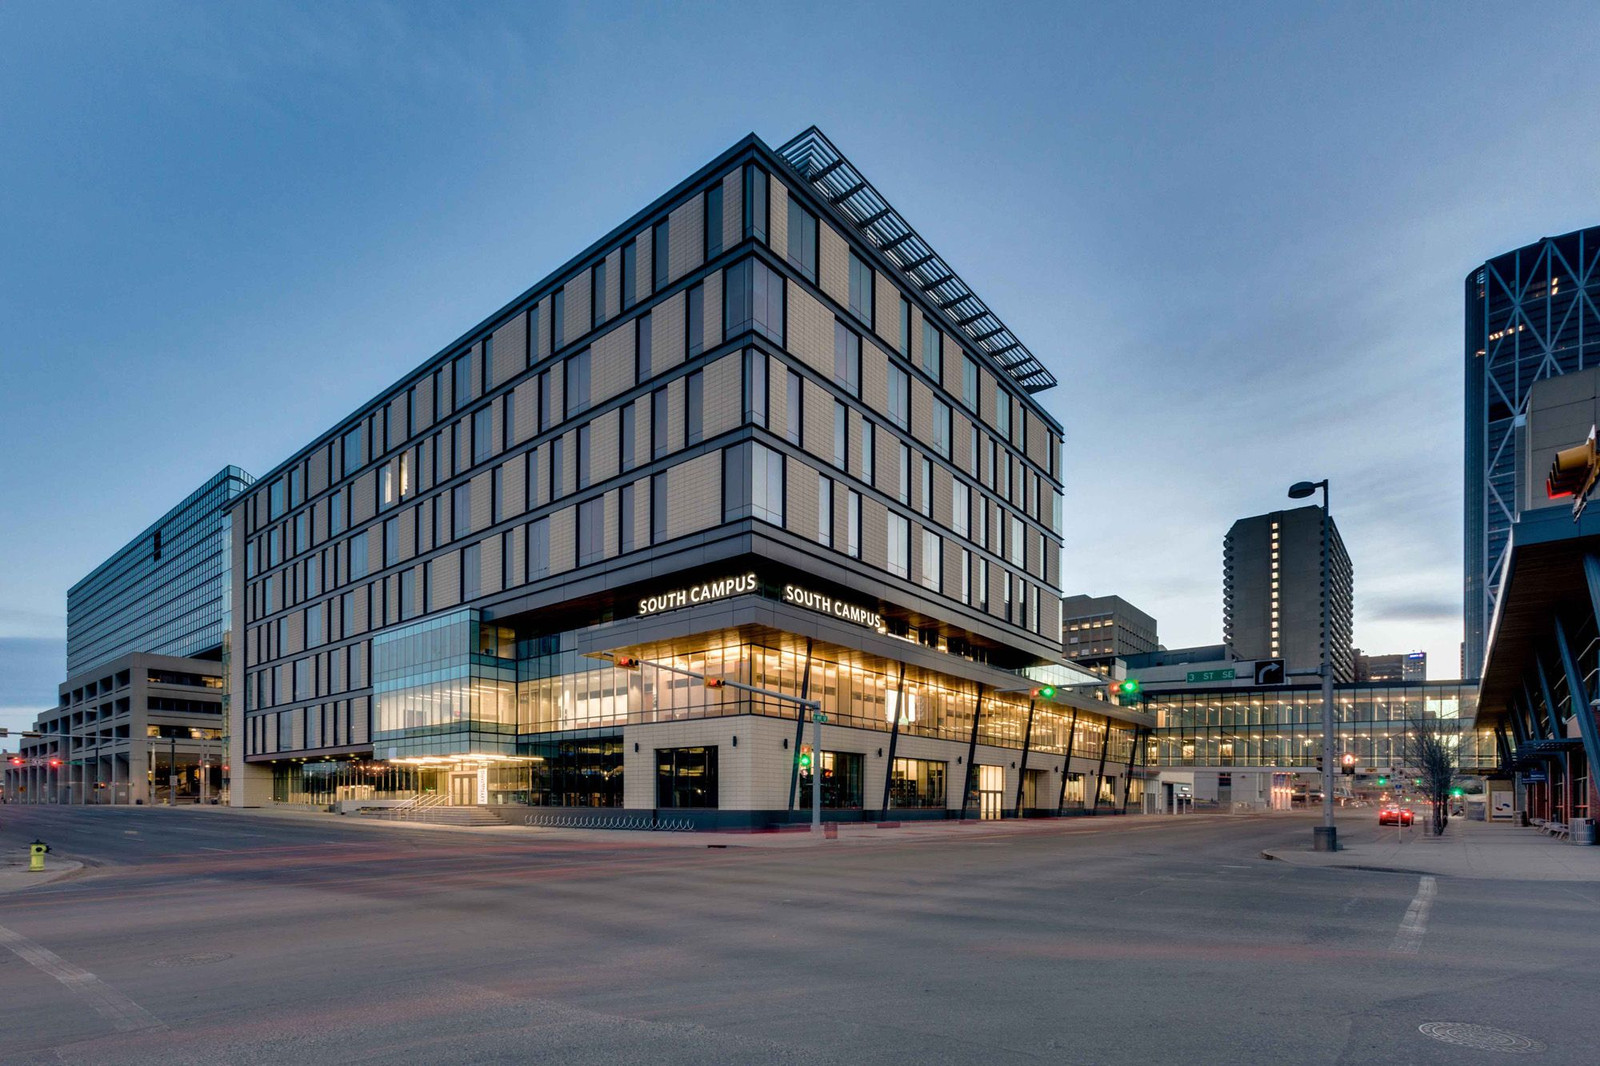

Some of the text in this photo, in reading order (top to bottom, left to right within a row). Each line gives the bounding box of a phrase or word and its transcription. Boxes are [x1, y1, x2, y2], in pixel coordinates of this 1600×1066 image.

[639, 574, 756, 615] SOUTH CAMPUS
[786, 585, 881, 628] SOUTH CAMPUS
[1189, 673, 1195, 681] 3
[1203, 672, 1214, 680] ST
